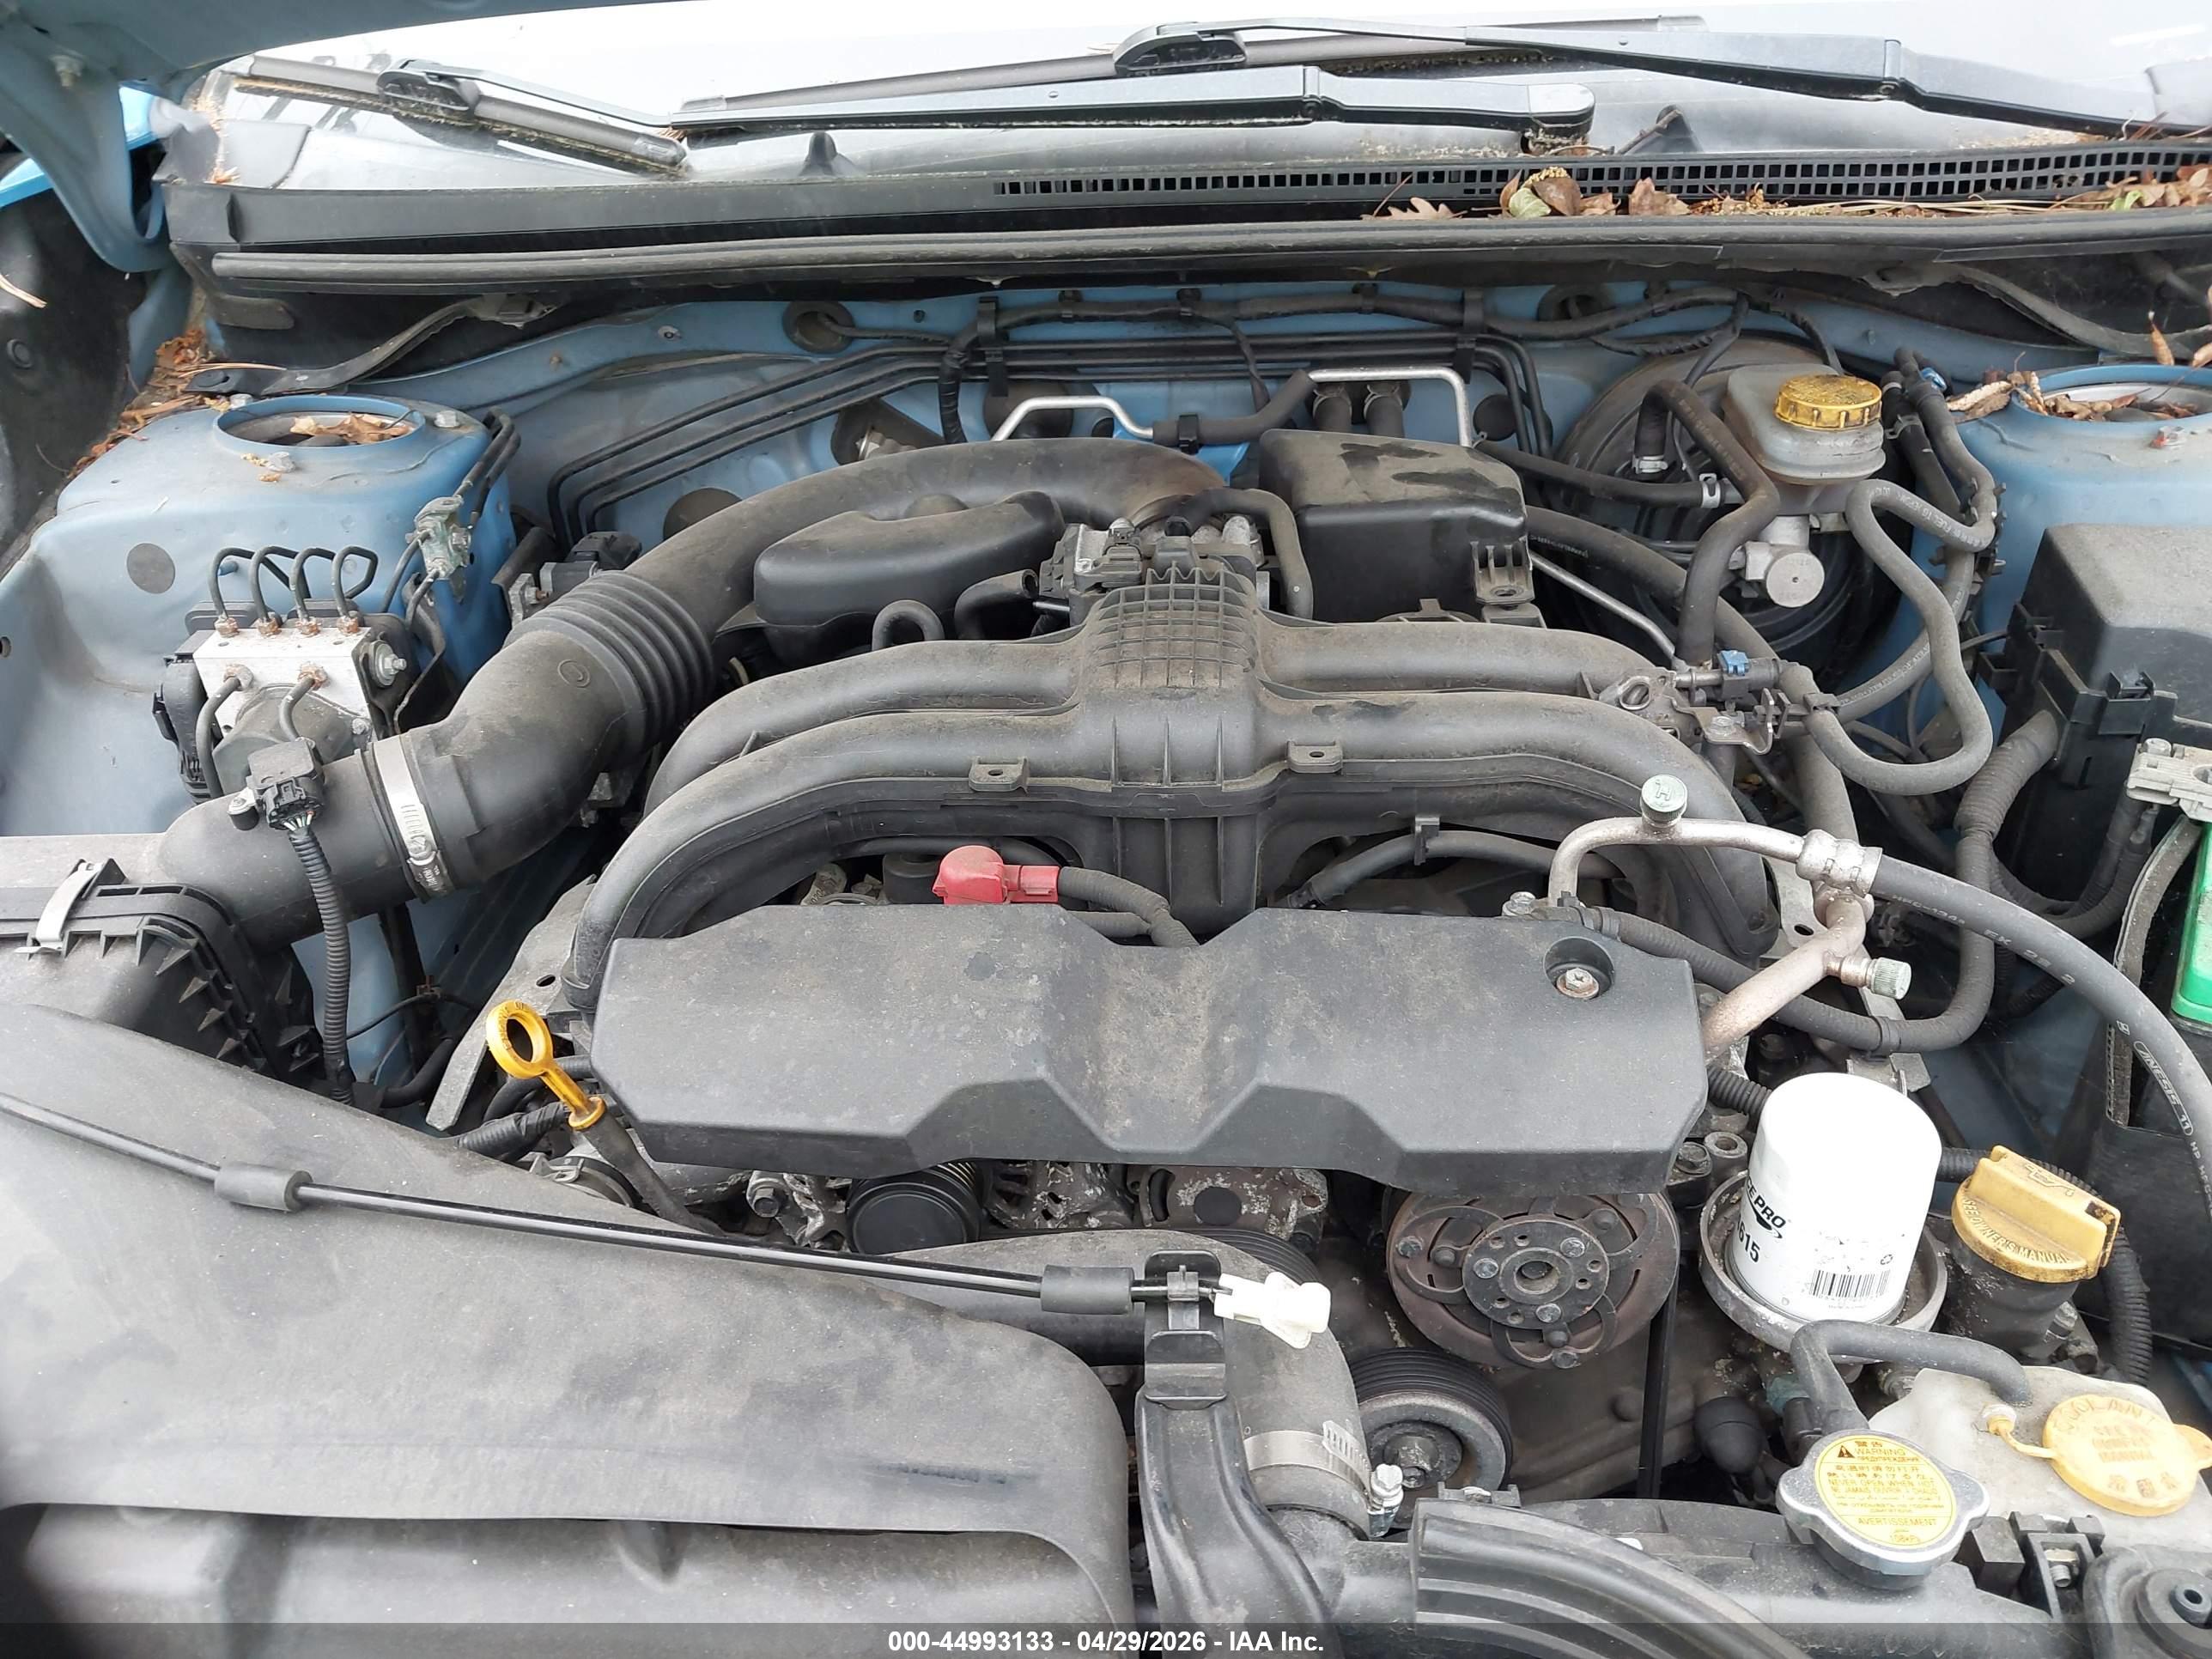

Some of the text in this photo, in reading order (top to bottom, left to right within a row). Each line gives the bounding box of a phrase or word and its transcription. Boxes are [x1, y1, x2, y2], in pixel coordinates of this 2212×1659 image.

[1753, 1194, 1786, 1229] PRO
[1963, 1197, 2071, 1265] SEE OWNER'S MANUAL
[1856, 1448, 1906, 1456] WARNING
[1888, 1480, 1915, 1488] WHEN
[1858, 1517, 1938, 1527] AVERTISSEMENT
